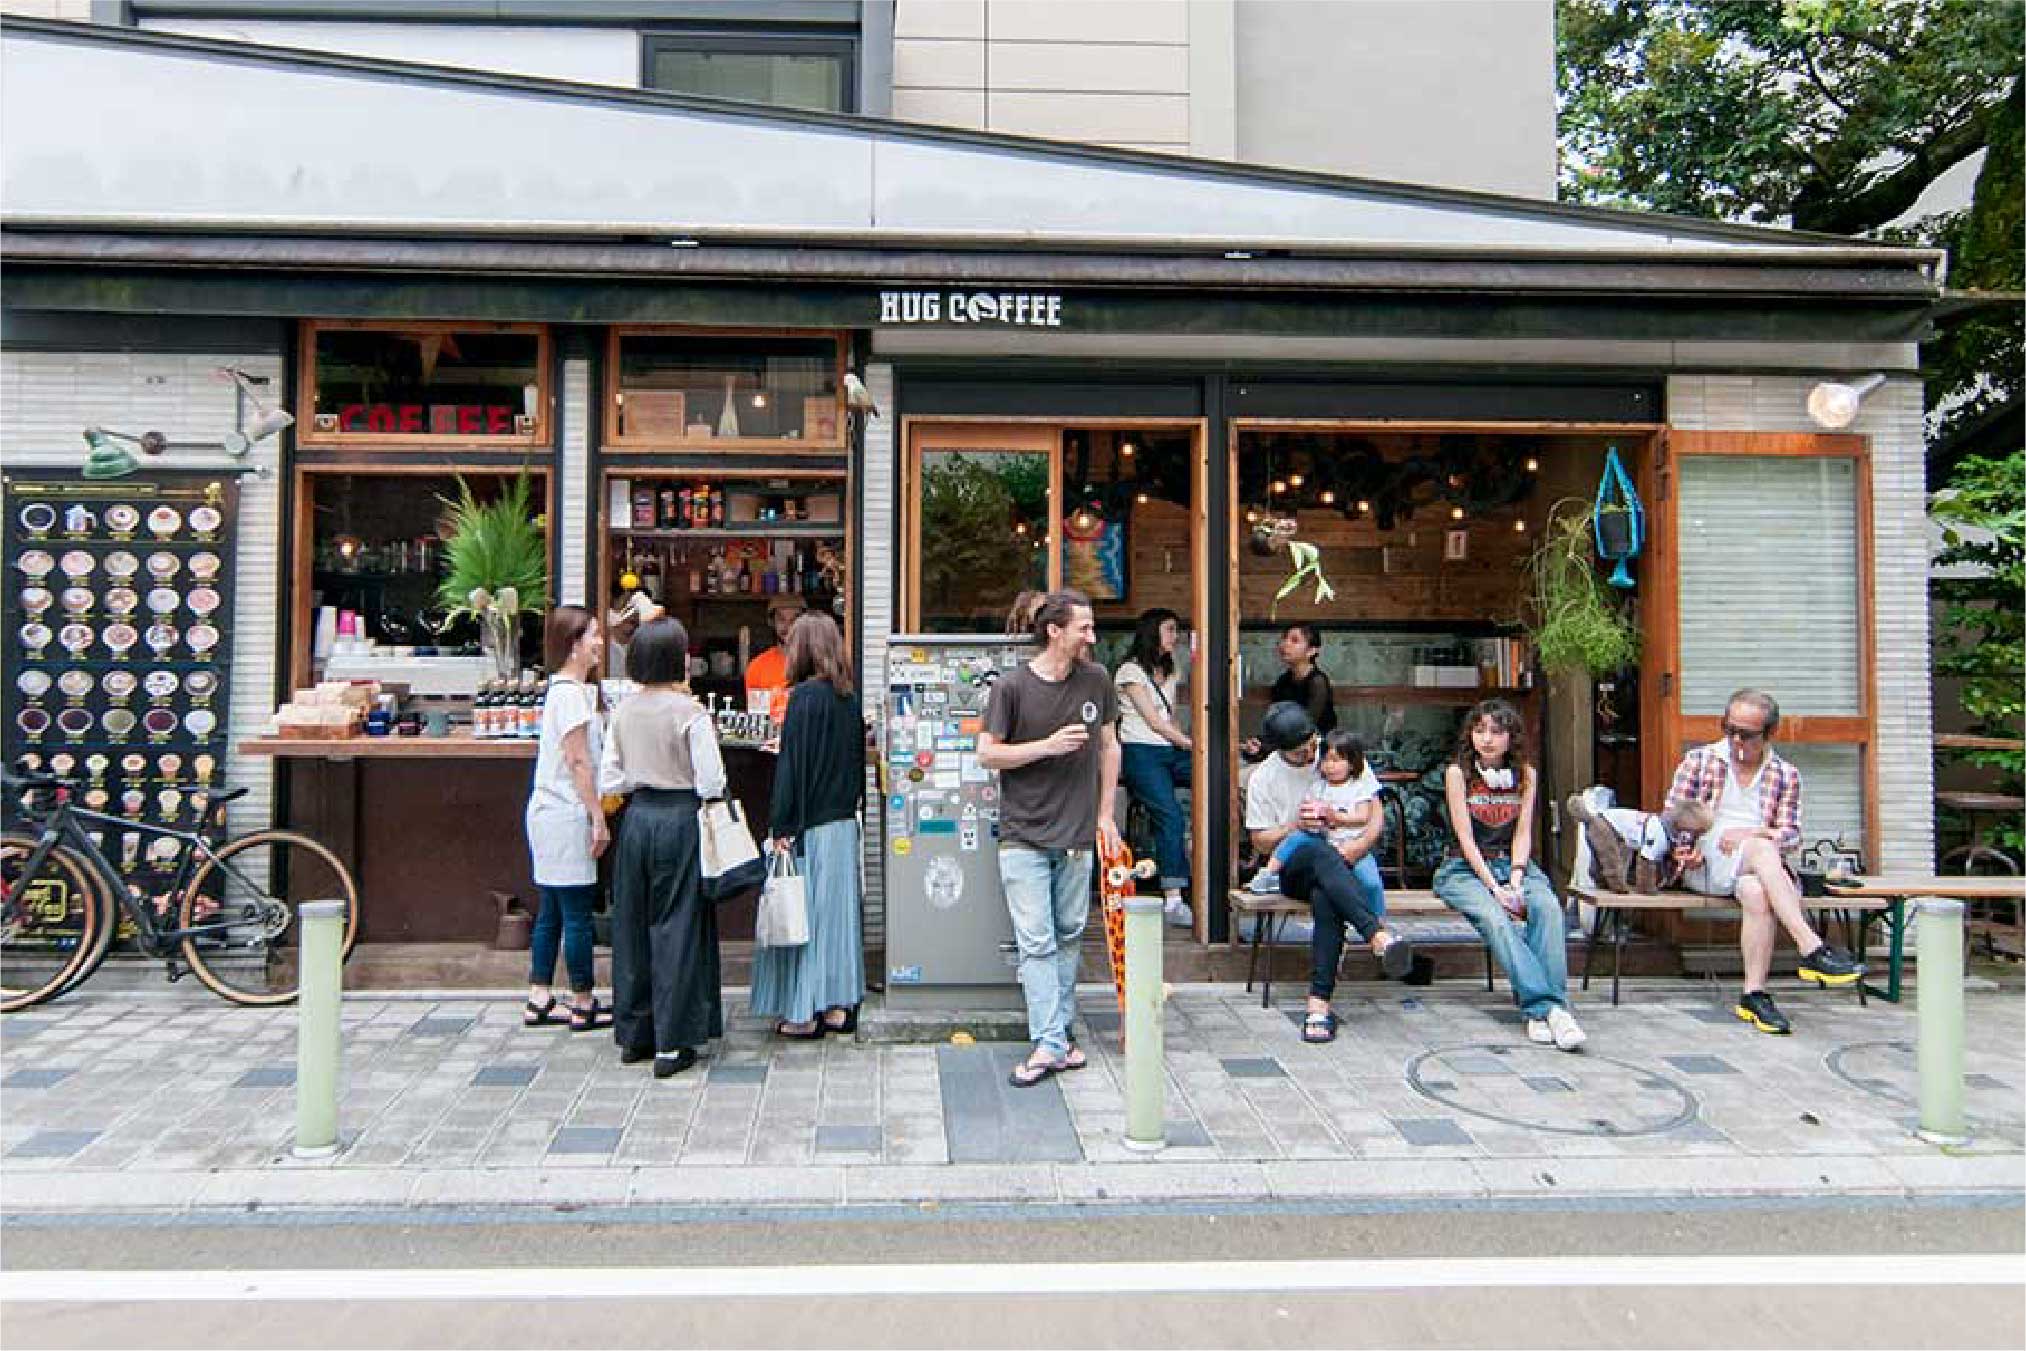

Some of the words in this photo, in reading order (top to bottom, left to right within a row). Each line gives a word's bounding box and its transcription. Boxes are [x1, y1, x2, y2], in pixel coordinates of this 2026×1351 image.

[879, 291, 941, 323] HUG
[948, 292, 1063, 326] COFFEE
[341, 403, 513, 435] COFFEE
